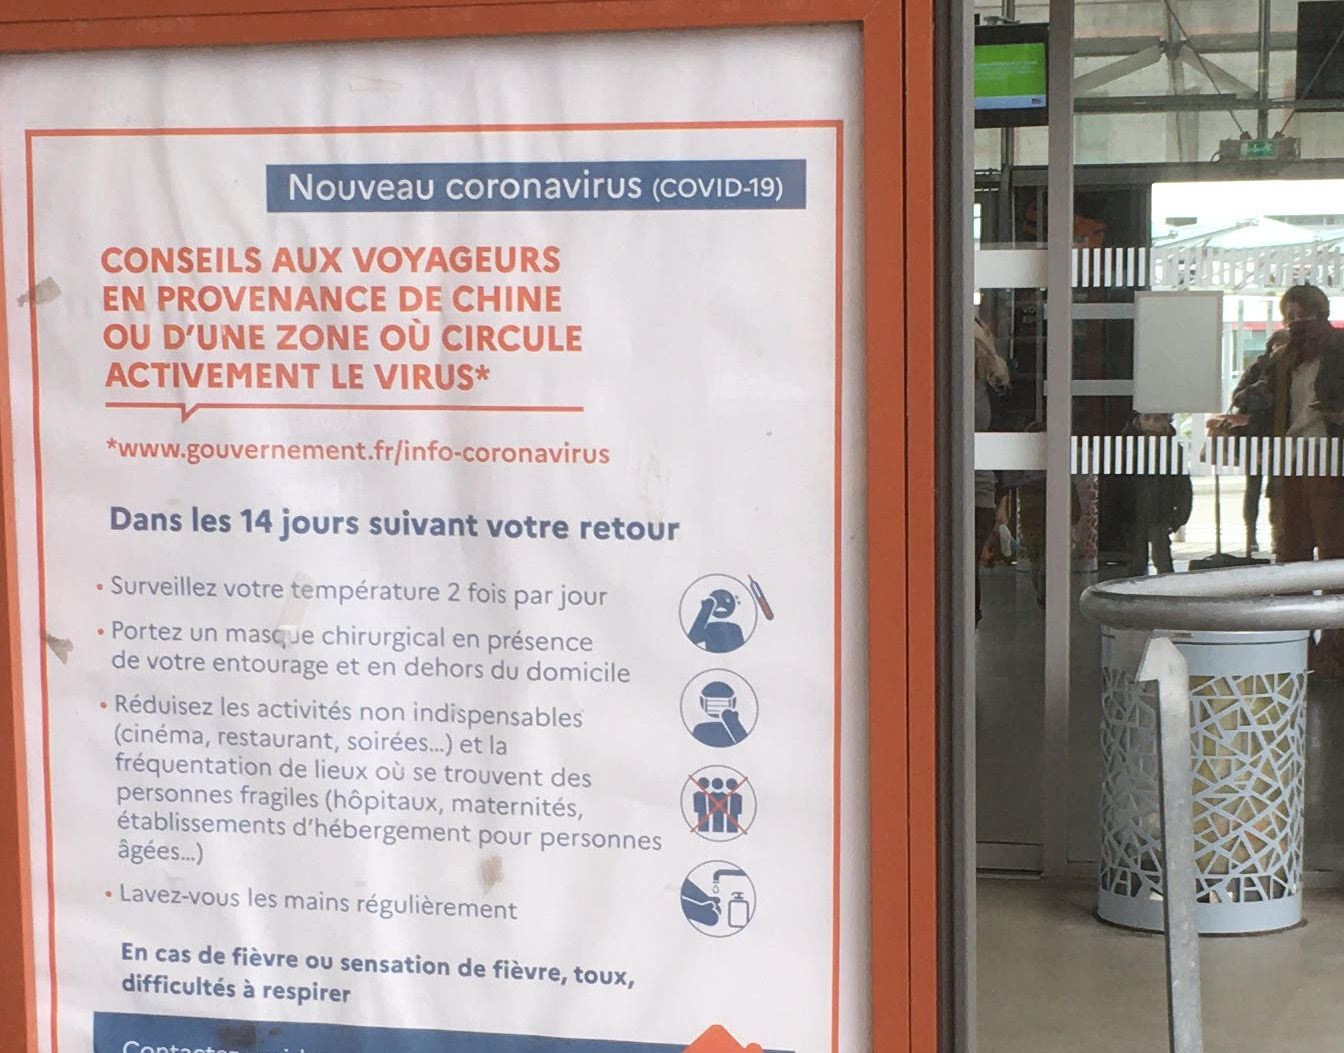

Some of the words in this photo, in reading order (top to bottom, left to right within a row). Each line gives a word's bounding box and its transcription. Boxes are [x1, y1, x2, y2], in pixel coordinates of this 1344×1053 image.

[290, 174, 433, 200] Nouveau
[447, 170, 641, 199] coronavirus
[653, 177, 782, 201] (COVID-19)
[101, 247, 261, 273] CONSEILS
[272, 247, 342, 273] AUX
[352, 246, 560, 273] VOYAGEURS
[104, 286, 145, 311] EN
[158, 286, 386, 312] PROVENANCE
[400, 286, 442, 312] DE
[453, 285, 561, 312] CHINE
[104, 324, 150, 350] OU
[277, 325, 368, 350] ZONE
[380, 319, 429, 351] OÙ
[442, 325, 582, 352] CIRCULE
[105, 362, 320, 388] ACTIVEMENT
[332, 364, 363, 389] LE
[111, 507, 182, 532] Dans
[192, 506, 231, 533] les
[240, 509, 272, 533] 14
[280, 508, 359, 541] jours
[369, 510, 478, 536] suivant
[487, 516, 569, 539] votre
[581, 518, 679, 540] retour
[112, 576, 217, 596] Surveillez
[224, 581, 283, 598] votre
[291, 580, 439, 605] température
[448, 582, 460, 601] 2
[468, 582, 506, 603] fois
[515, 590, 553, 610] par
[558, 585, 607, 611] jour
[113, 621, 182, 641] Portez
[191, 628, 217, 641] un
[226, 628, 314, 649] masque
[322, 625, 444, 652] chirurgical
[453, 634, 479, 648] en
[488, 630, 592, 654] présence
[112, 650, 139, 669] de
[147, 654, 205, 671] votre
[213, 656, 328, 680] entourage
[337, 659, 359, 675] et
[368, 661, 395, 676] en
[405, 657, 483, 678] dehors
[491, 660, 518, 680] du
[527, 661, 630, 683] domicile
[116, 694, 213, 715] Réduisez
[221, 697, 249, 717] les
[258, 699, 351, 720] activités
[360, 707, 404, 721] non
[414, 702, 582, 729] indispensables
[115, 723, 209, 748] (cinéma,
[218, 730, 339, 753] restaurant,
[460, 737, 482, 754] et
[490, 735, 506, 755] la
[115, 752, 271, 779] fréquentation
[279, 758, 306, 778] de
[315, 759, 367, 779] lieux
[376, 761, 405, 781] où
[414, 767, 436, 782] se
[444, 766, 542, 786] trouvent
[551, 767, 591, 788] des
[118, 786, 232, 805] personnes
[240, 785, 318, 811] fragiles
[326, 789, 443, 815] (hôpitaux,
[453, 797, 582, 820] maternités,
[118, 810, 285, 835] établissements
[479, 829, 532, 849] pour
[541, 832, 661, 851] personnes
[120, 884, 239, 907] Lavez-vous
[249, 888, 277, 908] les
[285, 891, 349, 912] mains
[358, 894, 517, 919] régulièrement
[122, 943, 147, 960] En
[156, 948, 191, 963] cas
[199, 945, 225, 965] de
[232, 947, 298, 968] fièvre
[306, 956, 333, 969] ou
[341, 955, 449, 975] sensation
[458, 958, 485, 977] de
[493, 960, 567, 985] fièvre,
[574, 967, 634, 989] toux,
[122, 973, 235, 997] difficultés
[243, 979, 255, 998] à
[264, 982, 351, 1005] respirer
